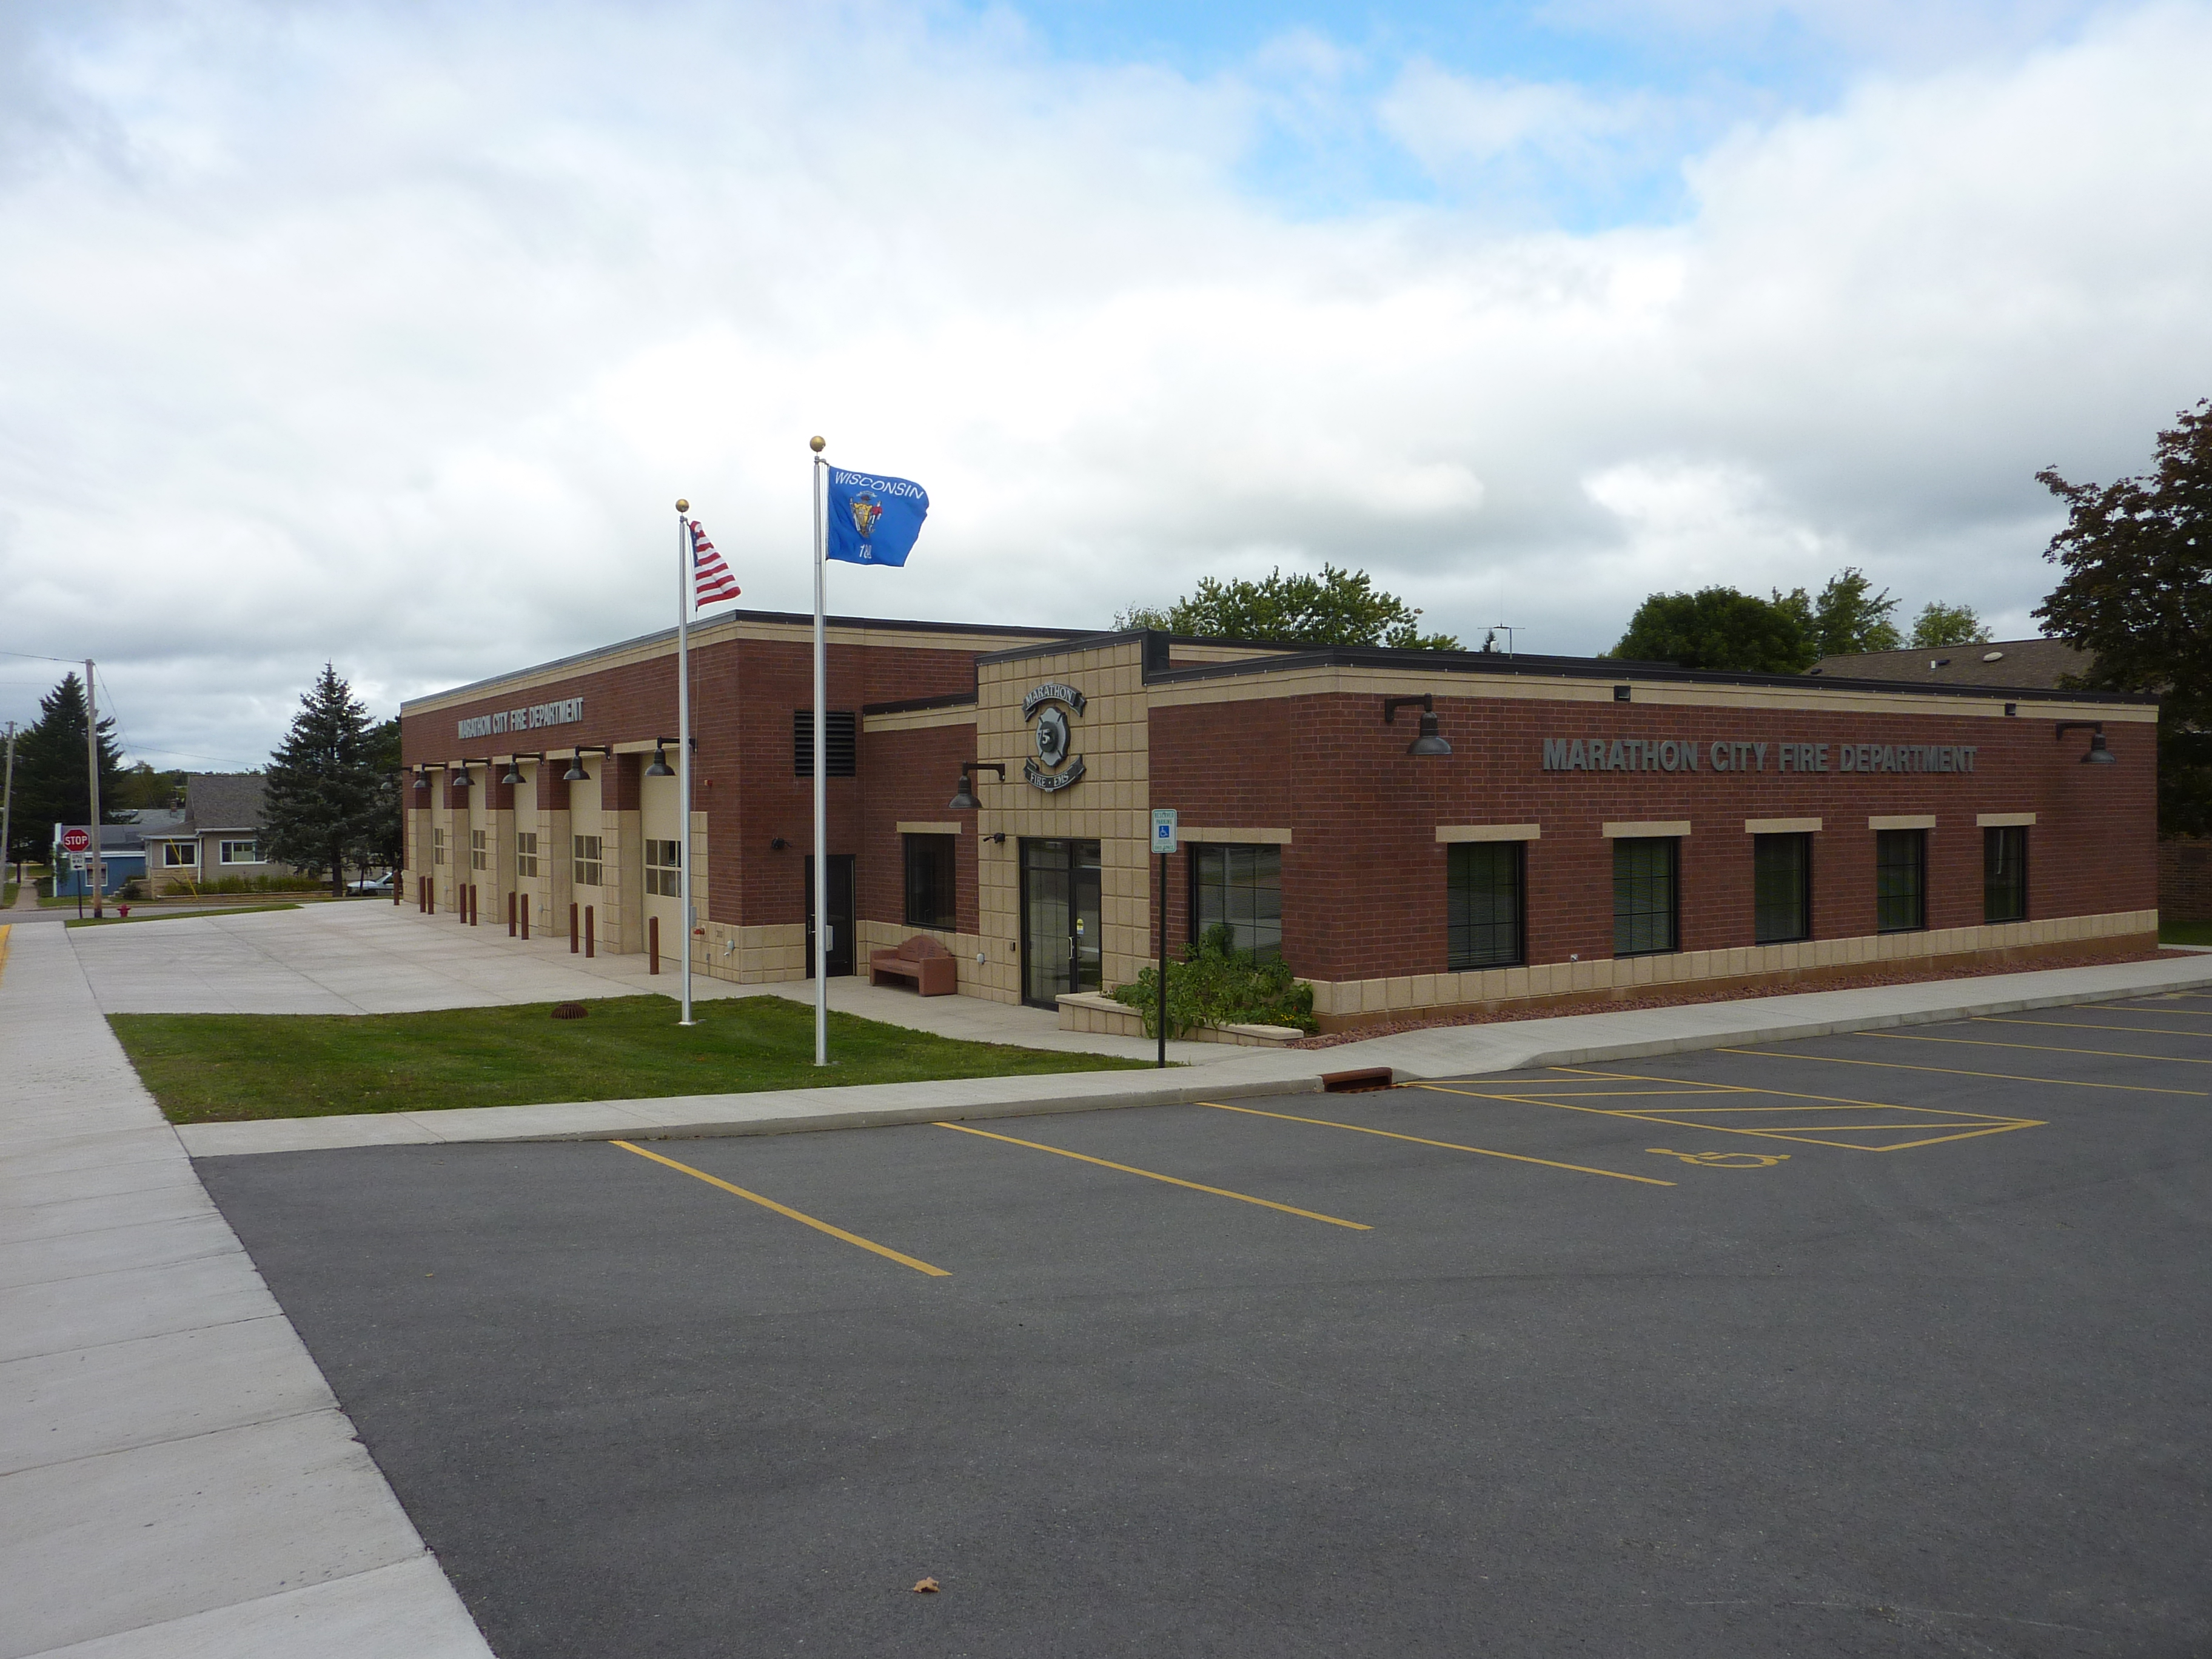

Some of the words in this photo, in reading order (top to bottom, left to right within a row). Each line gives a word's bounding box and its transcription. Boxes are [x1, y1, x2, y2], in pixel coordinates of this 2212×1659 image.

[835, 471, 924, 499] WISCONSIN
[1025, 685, 1073, 706] MARATHON
[458, 715, 491, 739] MARATHON
[493, 712, 508, 734] CITY
[511, 708, 528, 731] FIRE
[529, 697, 583, 728] DEPARTMENT
[1543, 739, 1697, 771] MARATHON
[1710, 742, 1768, 771] CITY
[1778, 743, 1829, 772] FIRE
[1839, 744, 1977, 773] DEPARTMENT
[1030, 773, 1046, 787] FIRE
[1054, 772, 1068, 786] EMS
[65, 836, 87, 845] STOP
